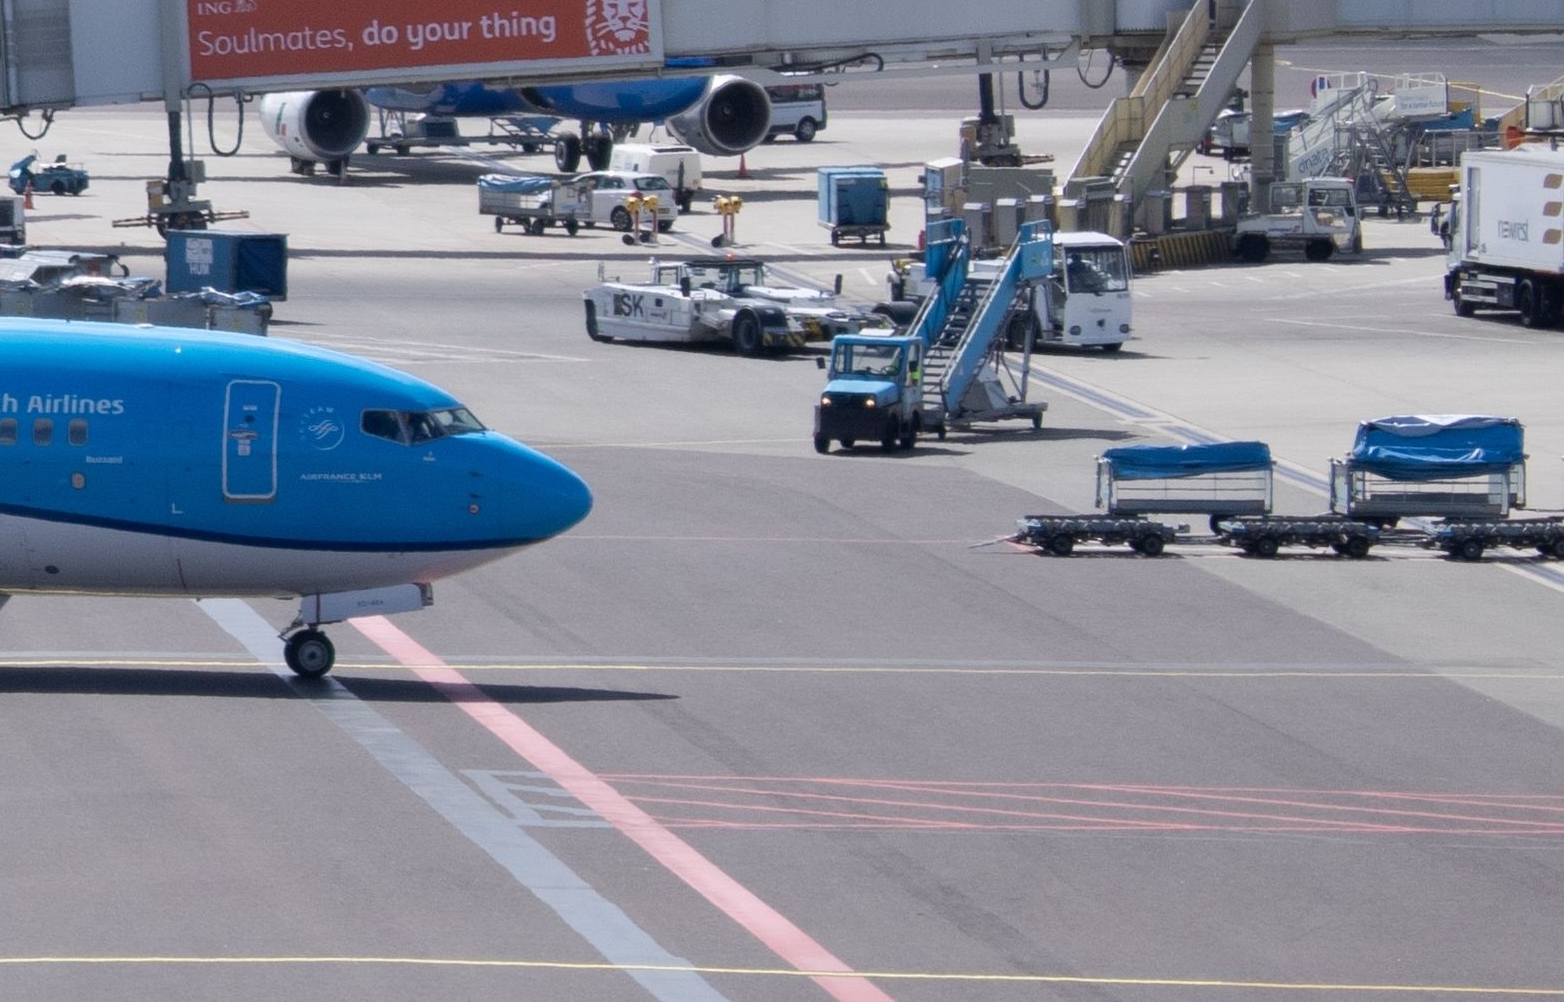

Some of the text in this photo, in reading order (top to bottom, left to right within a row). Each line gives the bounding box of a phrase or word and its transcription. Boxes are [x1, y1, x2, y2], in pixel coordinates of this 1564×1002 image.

[197, 1, 232, 15] ING
[198, 11, 556, 56] Soulmates, do your thing
[26, 394, 125, 414] Airlines
